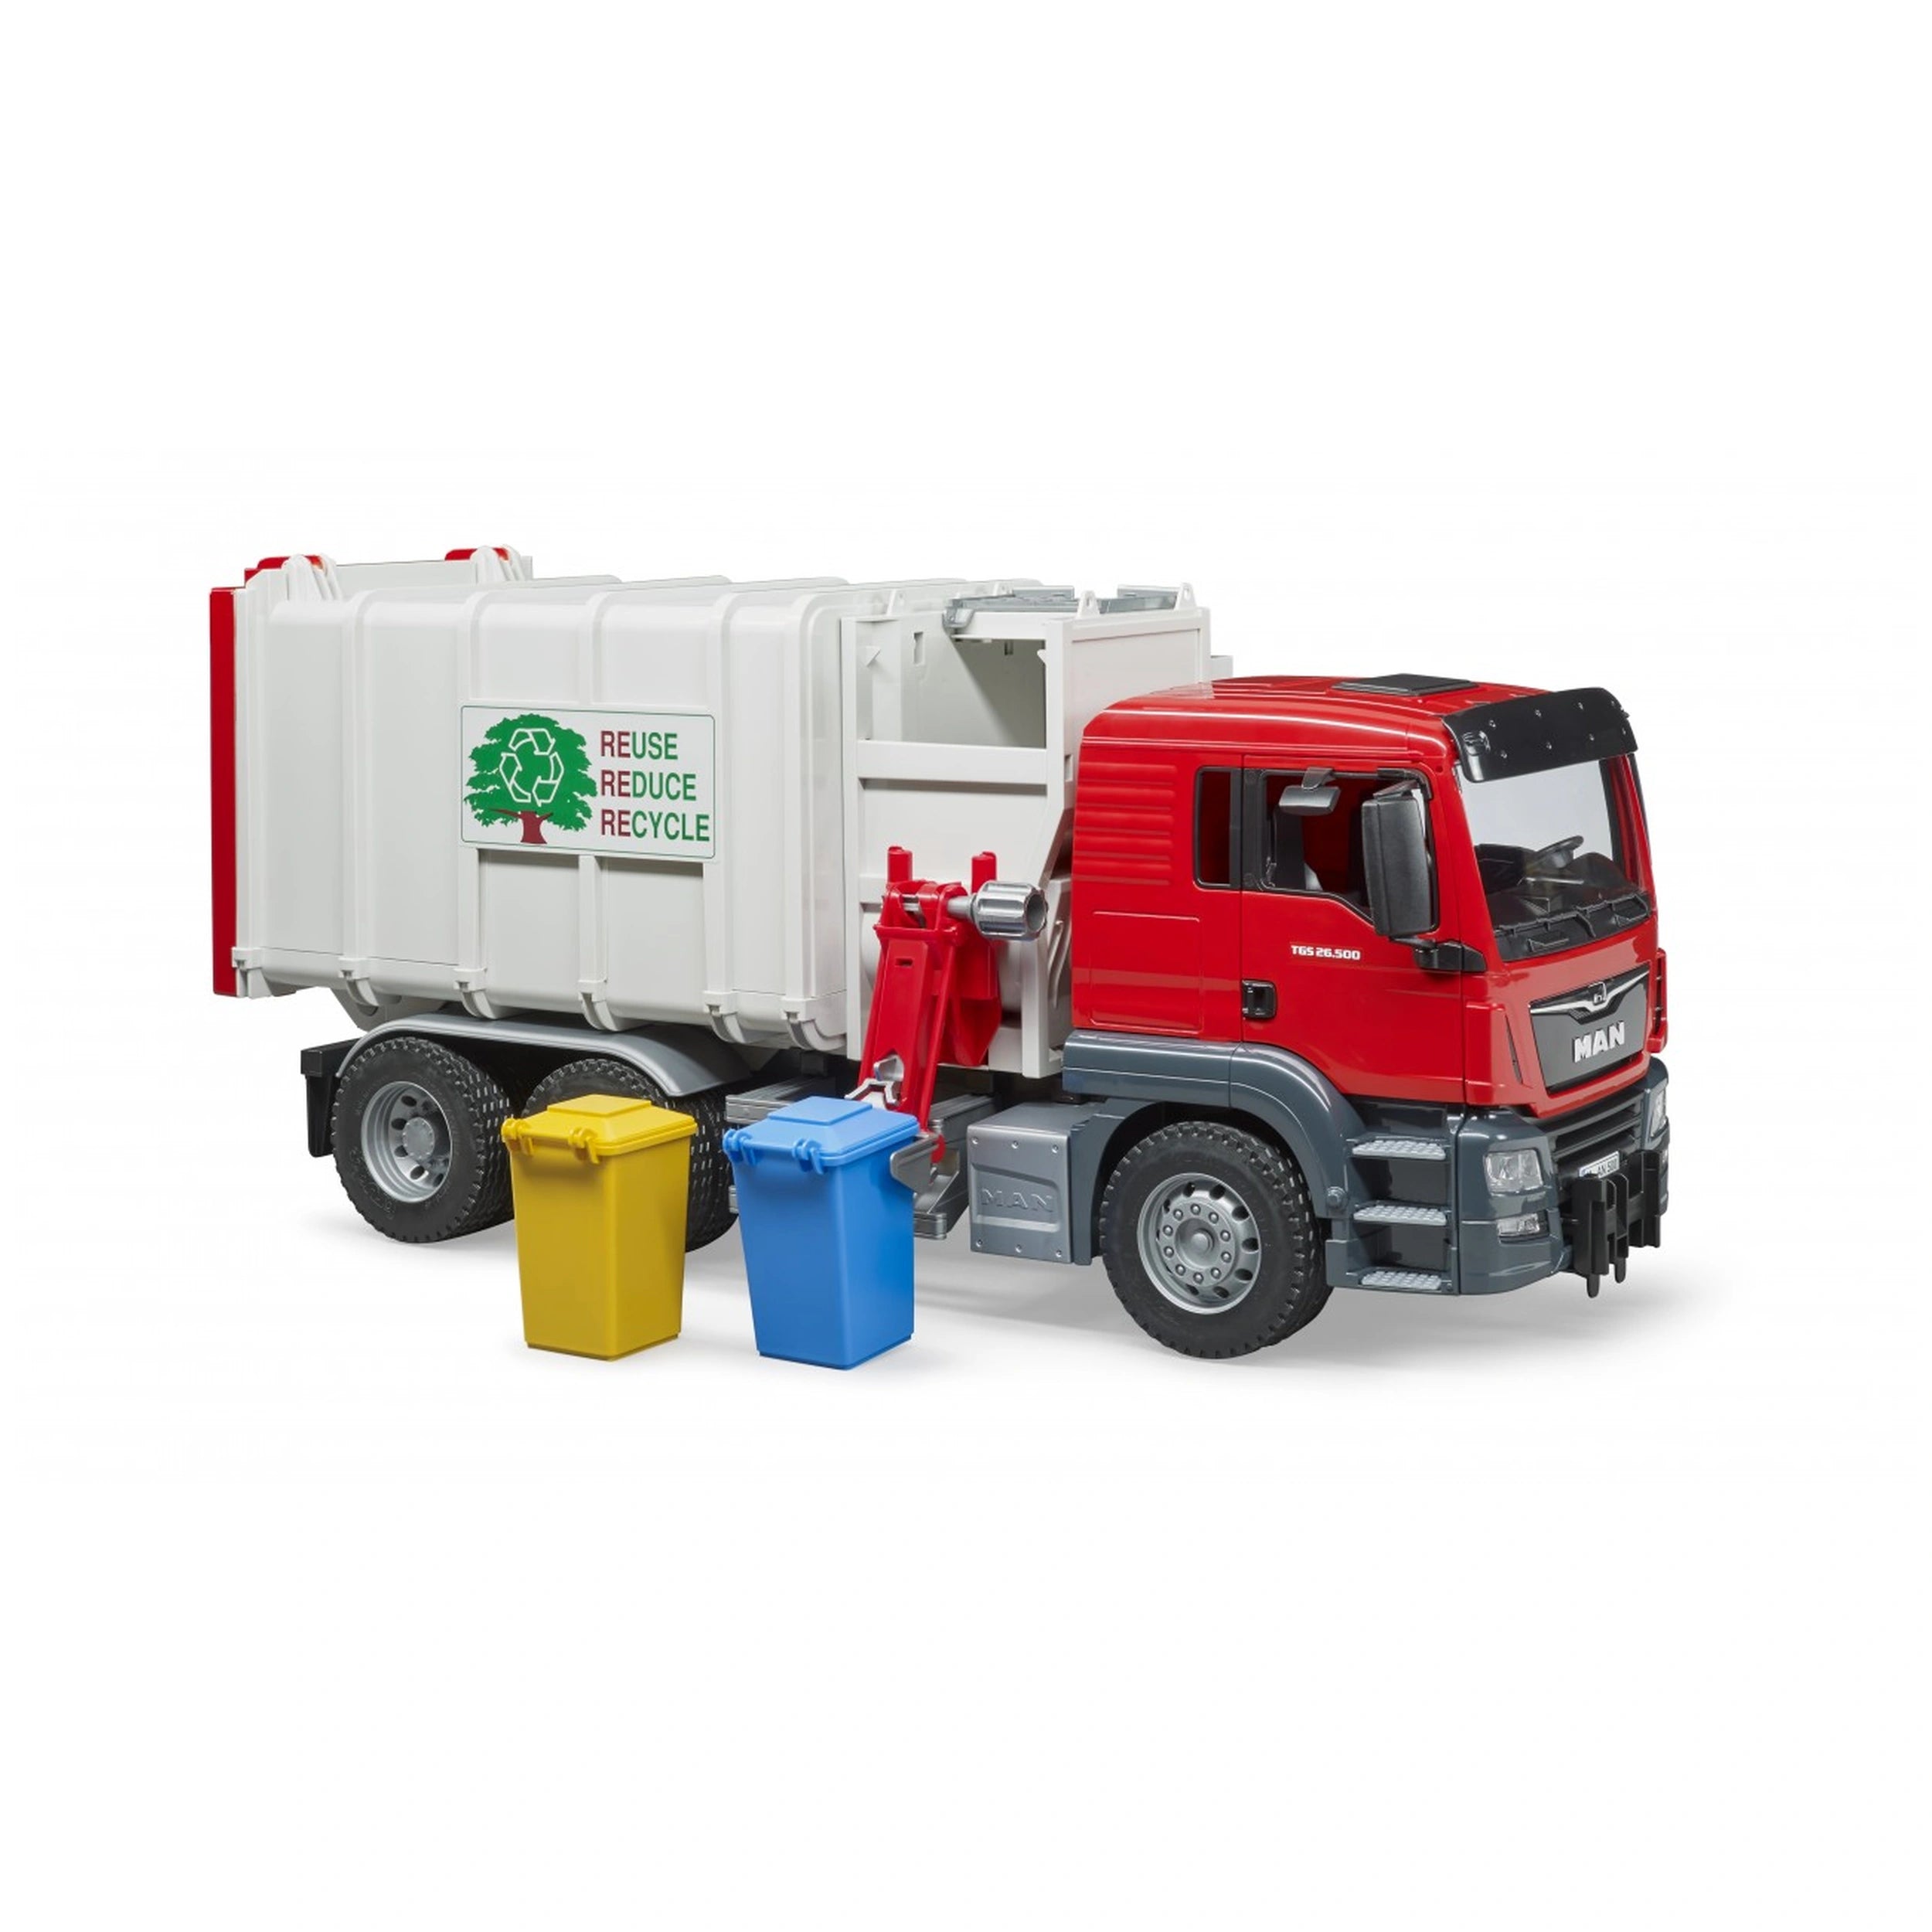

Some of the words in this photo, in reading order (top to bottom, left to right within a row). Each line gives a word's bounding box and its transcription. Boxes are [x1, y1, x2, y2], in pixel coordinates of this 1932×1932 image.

[600, 730, 678, 760] REUSE
[600, 770, 696, 801] REDUCE
[601, 808, 709, 842] RECYCLE
[1291, 944, 1314, 957] TGS
[1316, 947, 1361, 961] 26.500
[1573, 1020, 1625, 1063] MAN
[981, 1188, 1054, 1213] MAN
